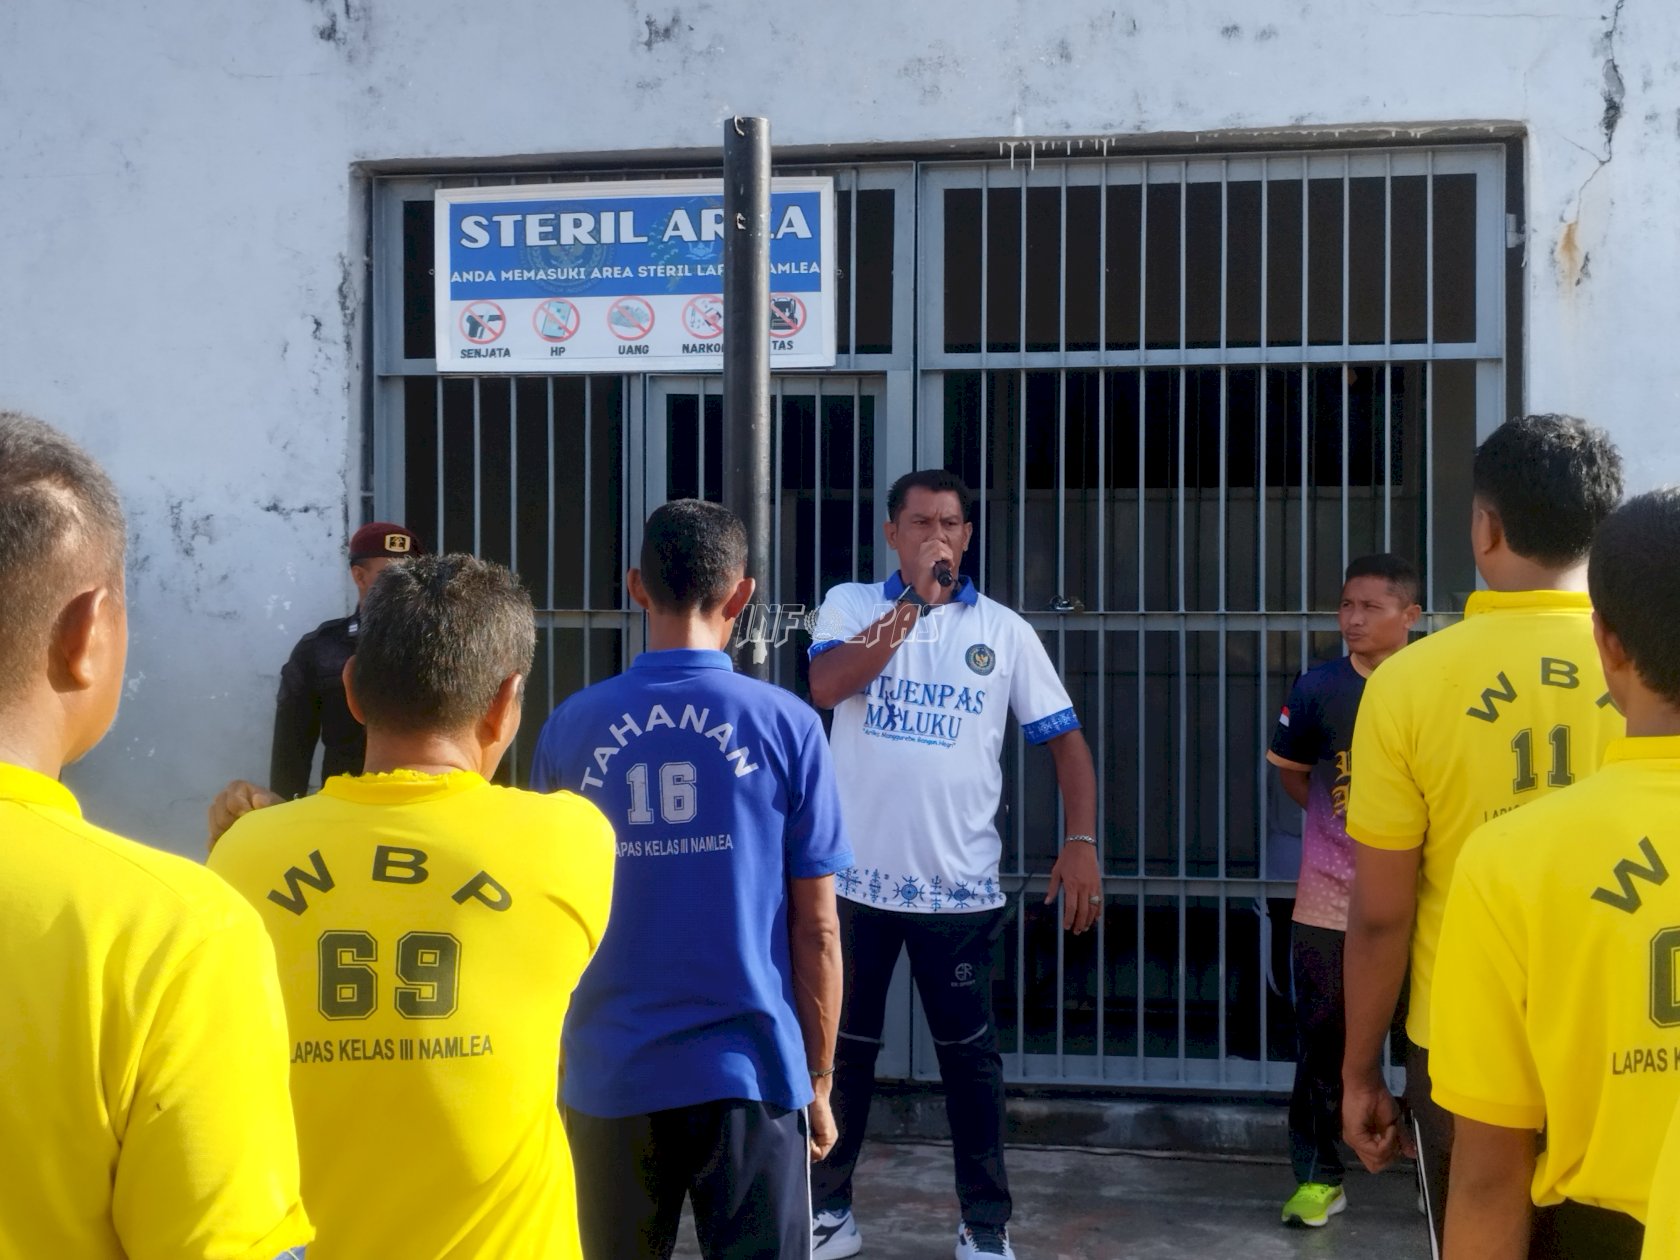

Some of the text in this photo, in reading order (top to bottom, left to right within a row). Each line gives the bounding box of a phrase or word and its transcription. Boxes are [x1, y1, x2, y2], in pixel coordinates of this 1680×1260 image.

[460, 205, 813, 249] STERIL ARA
[451, 271, 497, 283] ANDA
[501, 267, 586, 281] MEMASUKI
[590, 266, 634, 279] AREA
[638, 265, 692, 277] STERIL
[770, 261, 820, 275] AMLEA
[460, 347, 511, 359] SENJATA
[550, 346, 566, 357] HP
[618, 344, 649, 355] UANG
[682, 343, 724, 354] NARKO
[772, 340, 794, 351] TAS
[862, 675, 986, 715] ITJENPAS
[580, 704, 759, 791] TAHANAN
[1511, 724, 1575, 795] 11
[626, 761, 697, 825] 16
[615, 834, 734, 858] APAS KELAS III NAMLEA
[265, 845, 513, 917] WBP
[317, 929, 463, 1021] 69
[290, 1034, 494, 1064] APAS KELAS III NAMLEA
[1612, 1047, 1668, 1075] LAPAS
